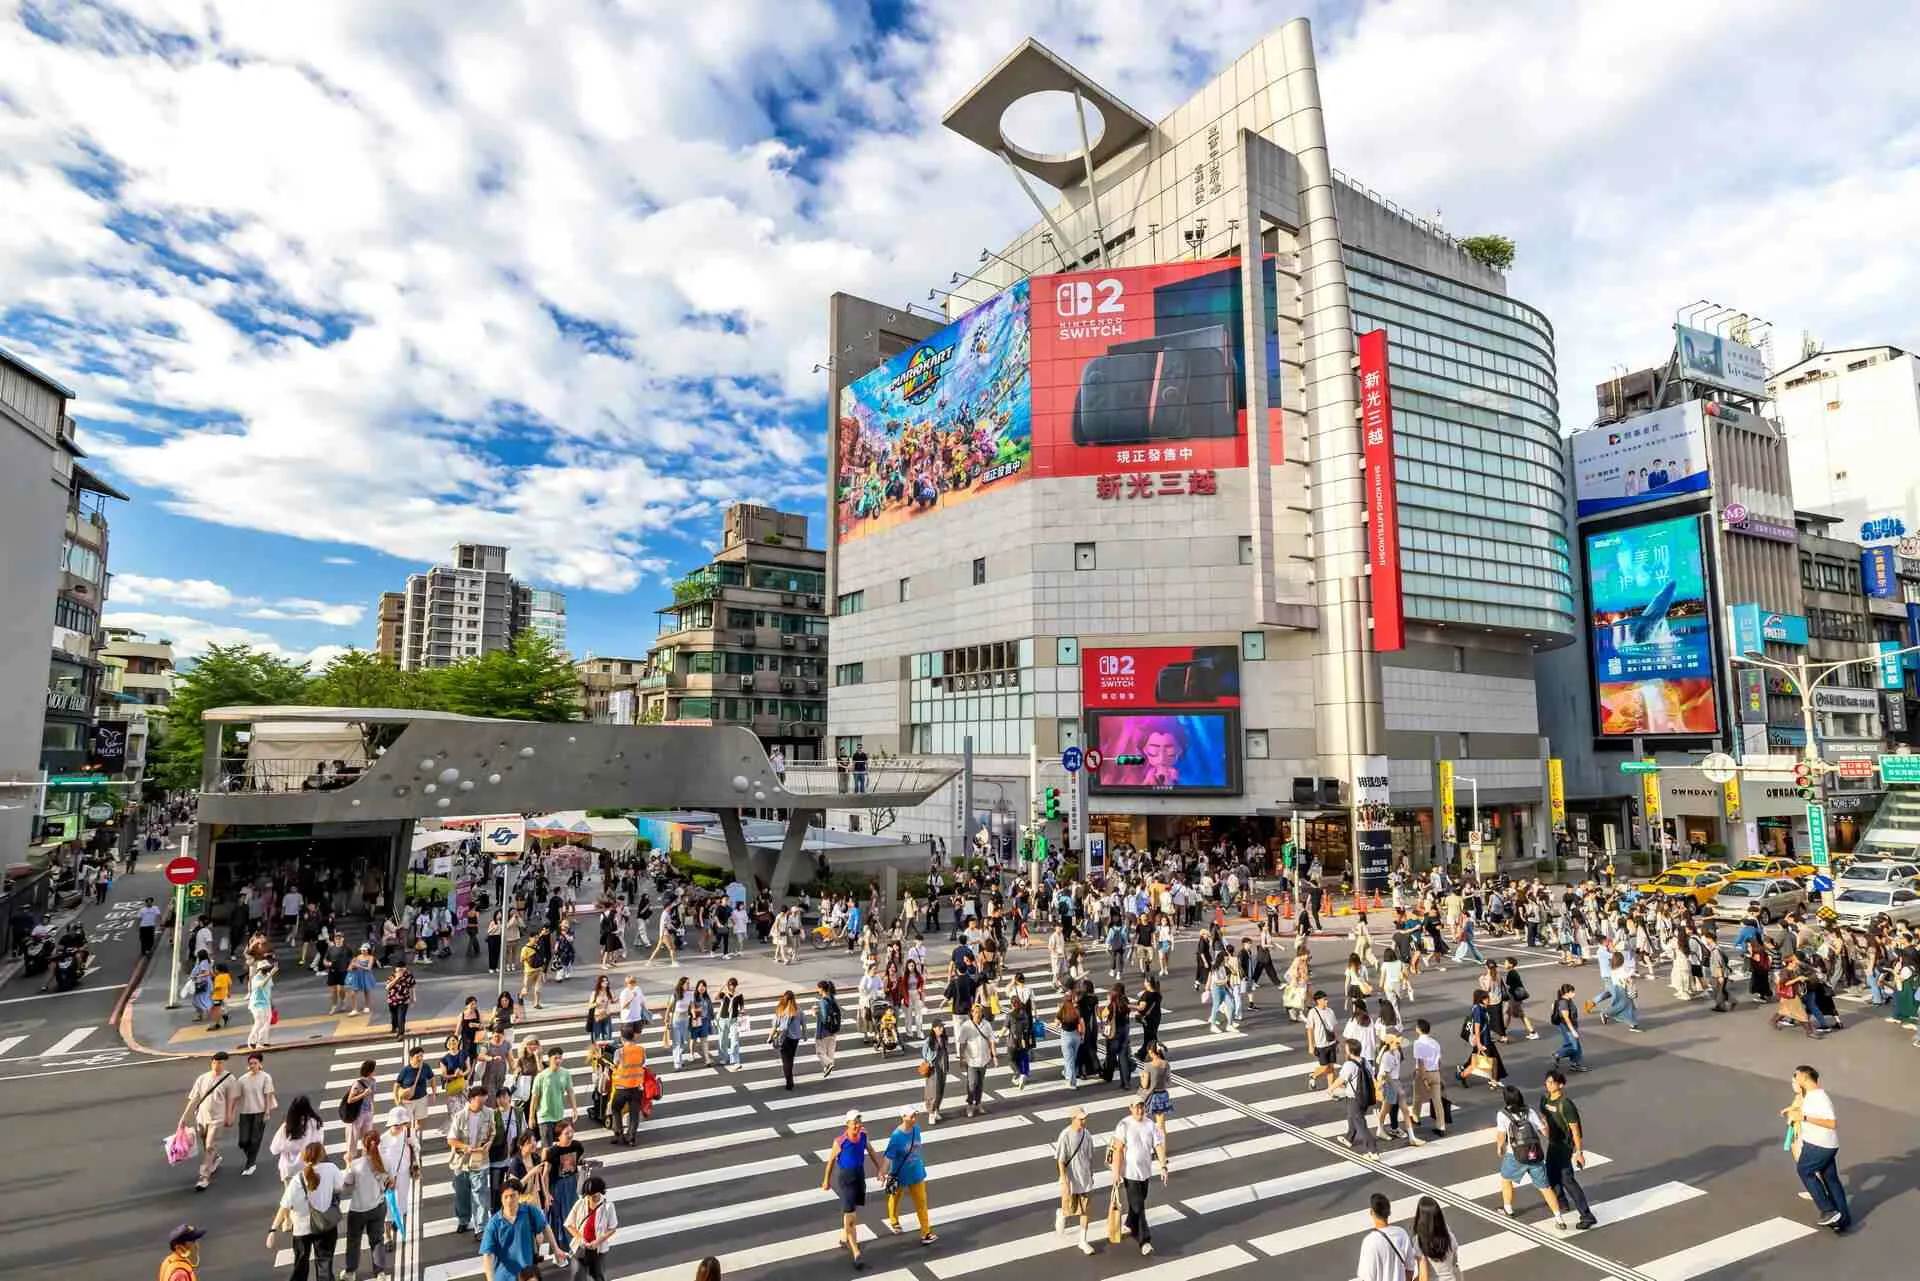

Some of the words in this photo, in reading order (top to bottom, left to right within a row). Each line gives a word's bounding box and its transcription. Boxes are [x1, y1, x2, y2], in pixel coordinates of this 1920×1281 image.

[1096, 279, 1125, 313] 2
[1060, 317, 1122, 328] NINTENDO
[1060, 325, 1122, 340] SWITCH
[1365, 371, 1384, 446] 新光三越
[1116, 448, 1194, 463] 現正發售中
[982, 459, 1021, 483] 現正發售中
[1096, 470, 1217, 500] 新光三越
[1119, 656, 1135, 675] 2
[1101, 680, 1135, 688] SWITCH
